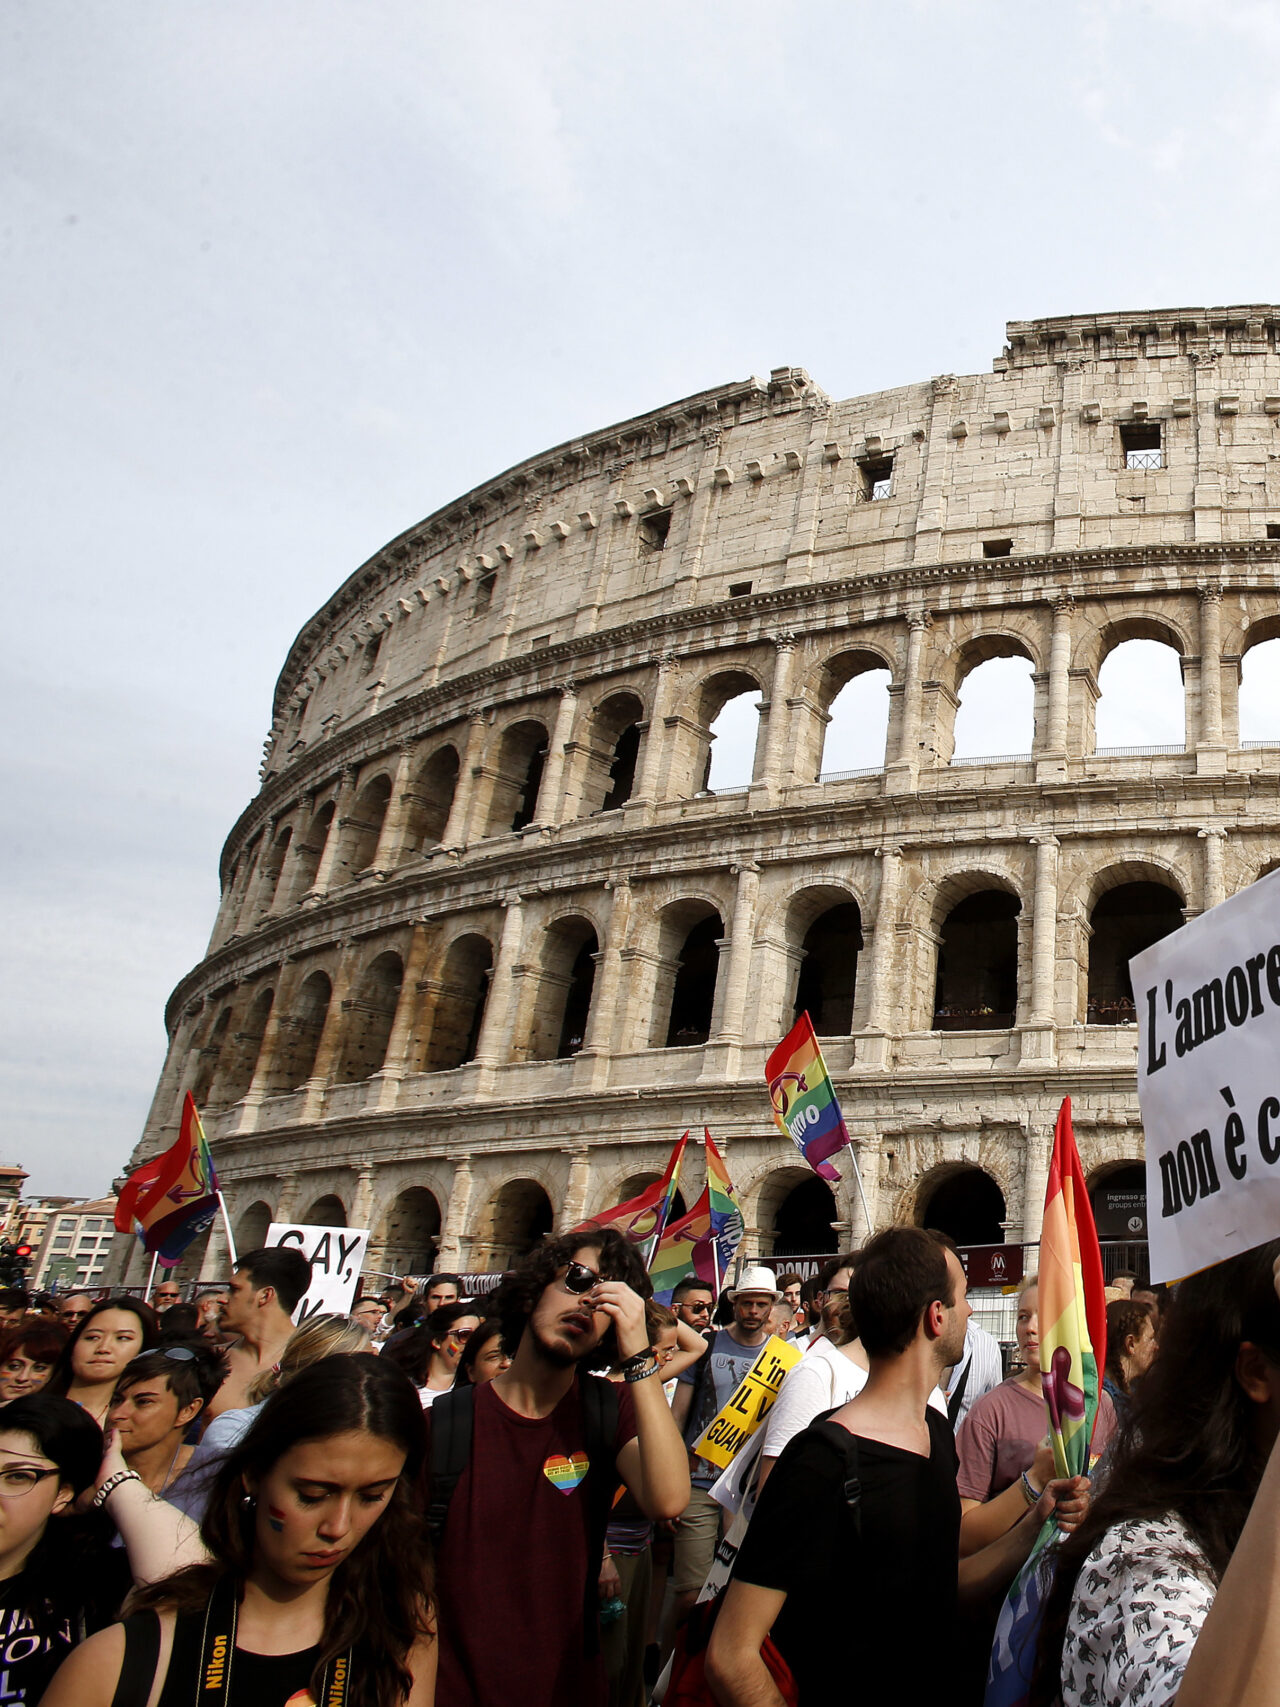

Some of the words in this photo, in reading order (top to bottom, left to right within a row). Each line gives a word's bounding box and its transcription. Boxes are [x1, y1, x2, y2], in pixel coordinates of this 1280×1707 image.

[1159, 1127, 1221, 1218] non
[1220, 1085, 1248, 1181] è
[1107, 1193, 1139, 1201] ingresso
[1108, 1202, 1132, 1210] groups
[730, 1385, 754, 1415] IL
[205, 1634, 228, 1690] Nikon
[328, 1657, 347, 1707] Nikon
